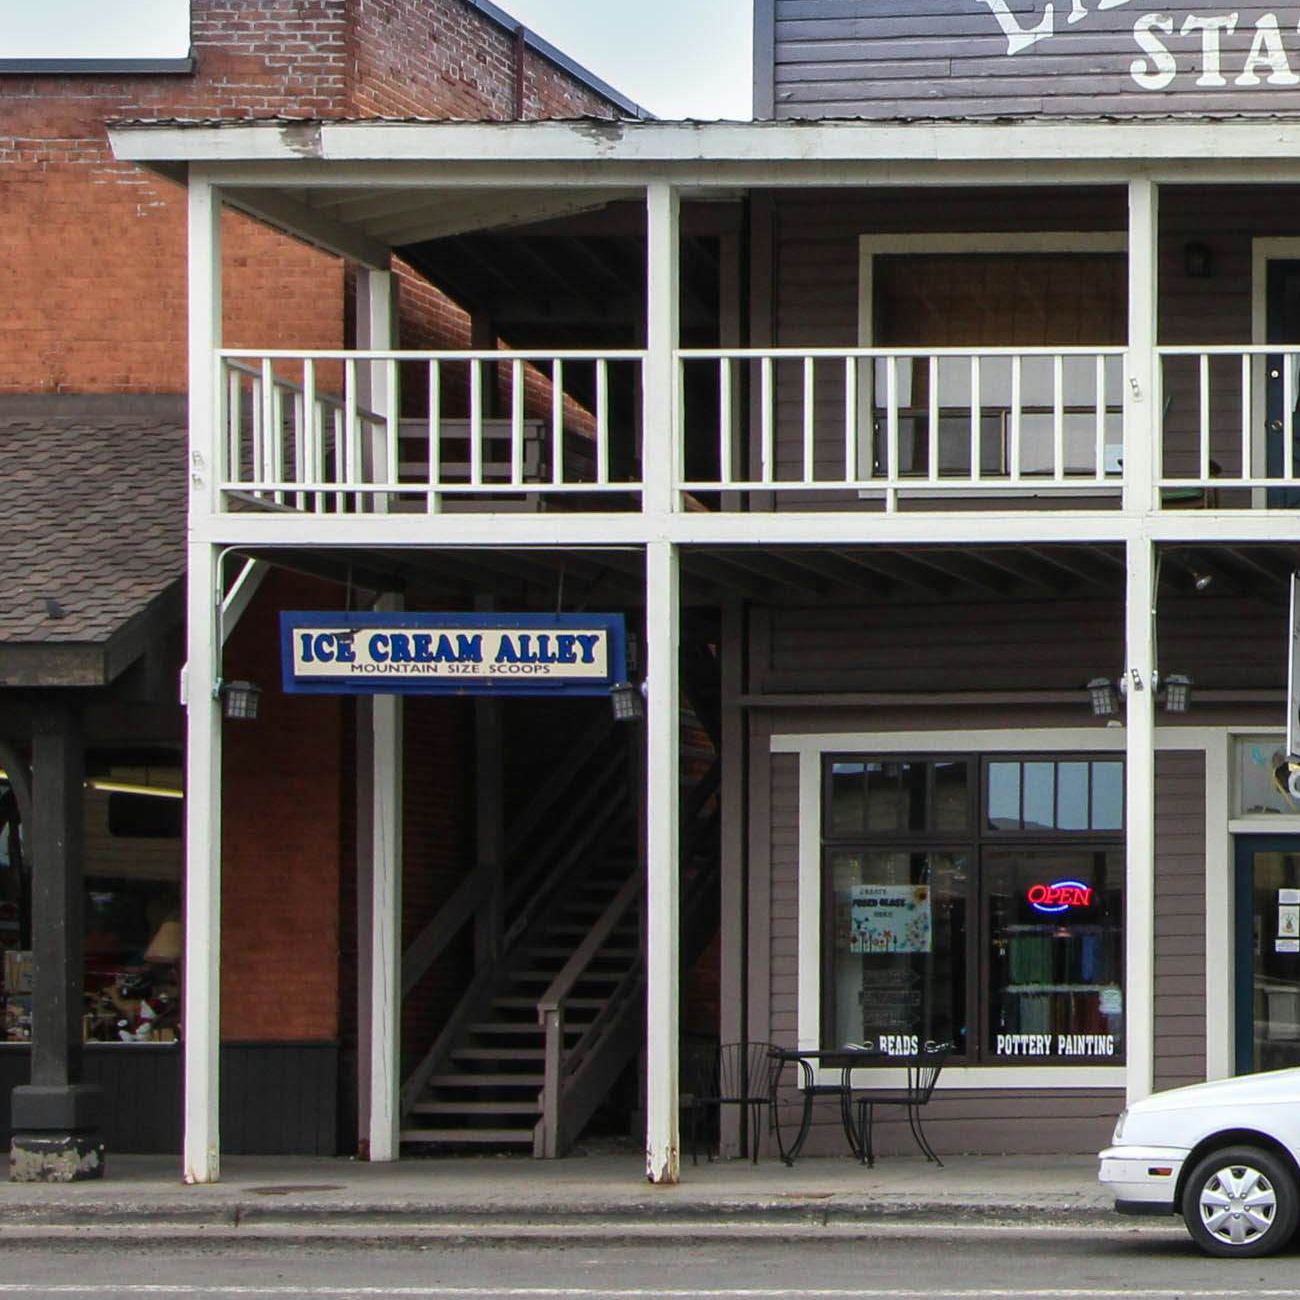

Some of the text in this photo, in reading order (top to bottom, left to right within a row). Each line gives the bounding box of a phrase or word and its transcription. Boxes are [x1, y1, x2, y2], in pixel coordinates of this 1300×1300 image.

[301, 633, 600, 663] ICE CREAM ALLEY
[351, 664, 551, 674] MOUNTAIN SIZE SCOOPS
[1028, 884, 1092, 906] OPEN
[879, 1035, 919, 1055] BEADS
[996, 1034, 1114, 1055] POTTERY PAINTING
